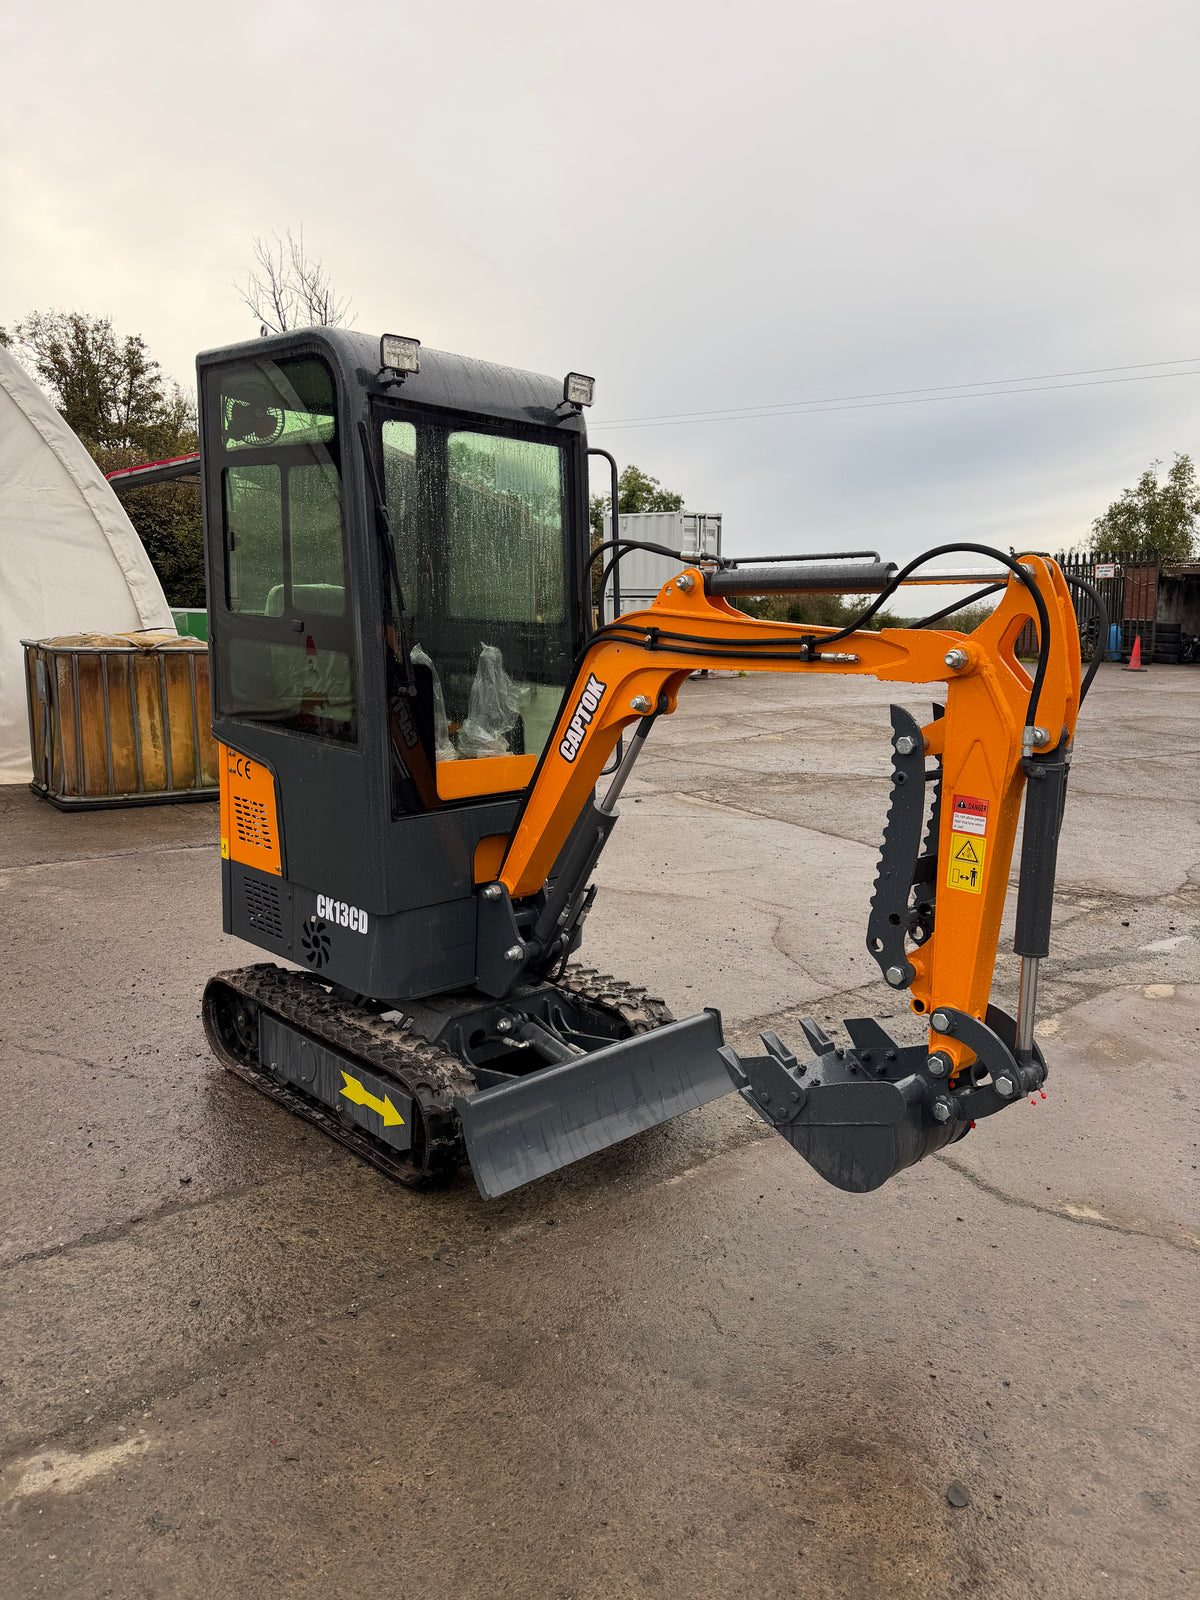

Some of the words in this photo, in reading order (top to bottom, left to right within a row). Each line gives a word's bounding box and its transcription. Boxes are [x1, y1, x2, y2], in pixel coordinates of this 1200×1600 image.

[559, 672, 607, 763] CAPTOK
[236, 758, 251, 780] CE
[968, 803, 987, 812] DANGER
[316, 893, 369, 935] CK13CD
